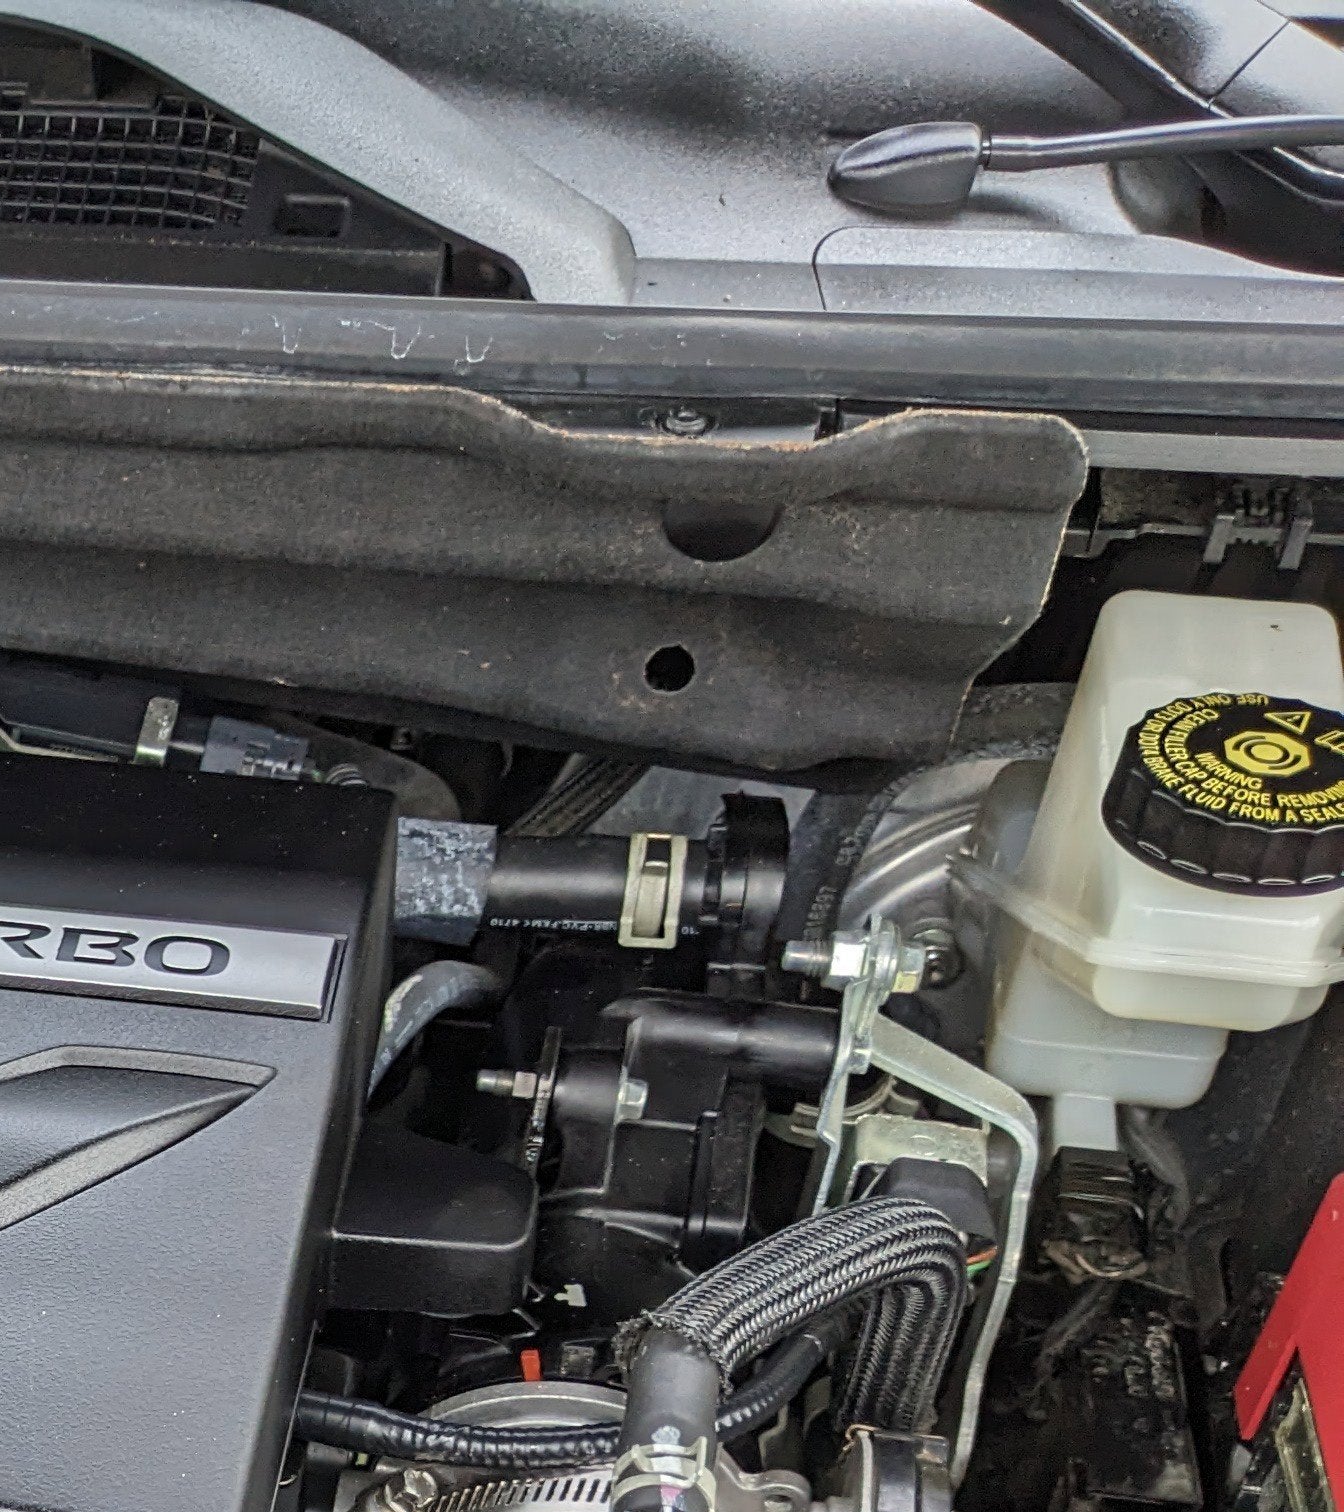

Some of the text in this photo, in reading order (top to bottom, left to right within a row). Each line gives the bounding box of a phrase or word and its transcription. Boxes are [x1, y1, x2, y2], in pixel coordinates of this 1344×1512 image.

[1172, 708, 1219, 730] CLEAN
[1164, 729, 1189, 762] FILLER
[1175, 761, 1208, 780] CAP
[1194, 752, 1262, 790] WARNING
[1143, 756, 1185, 790] BRAKE
[1178, 783, 1227, 811] FLUID
[1228, 801, 1280, 822] FROM
[1285, 809, 1298, 822] A
[1201, 777, 1272, 806] BEFORE
